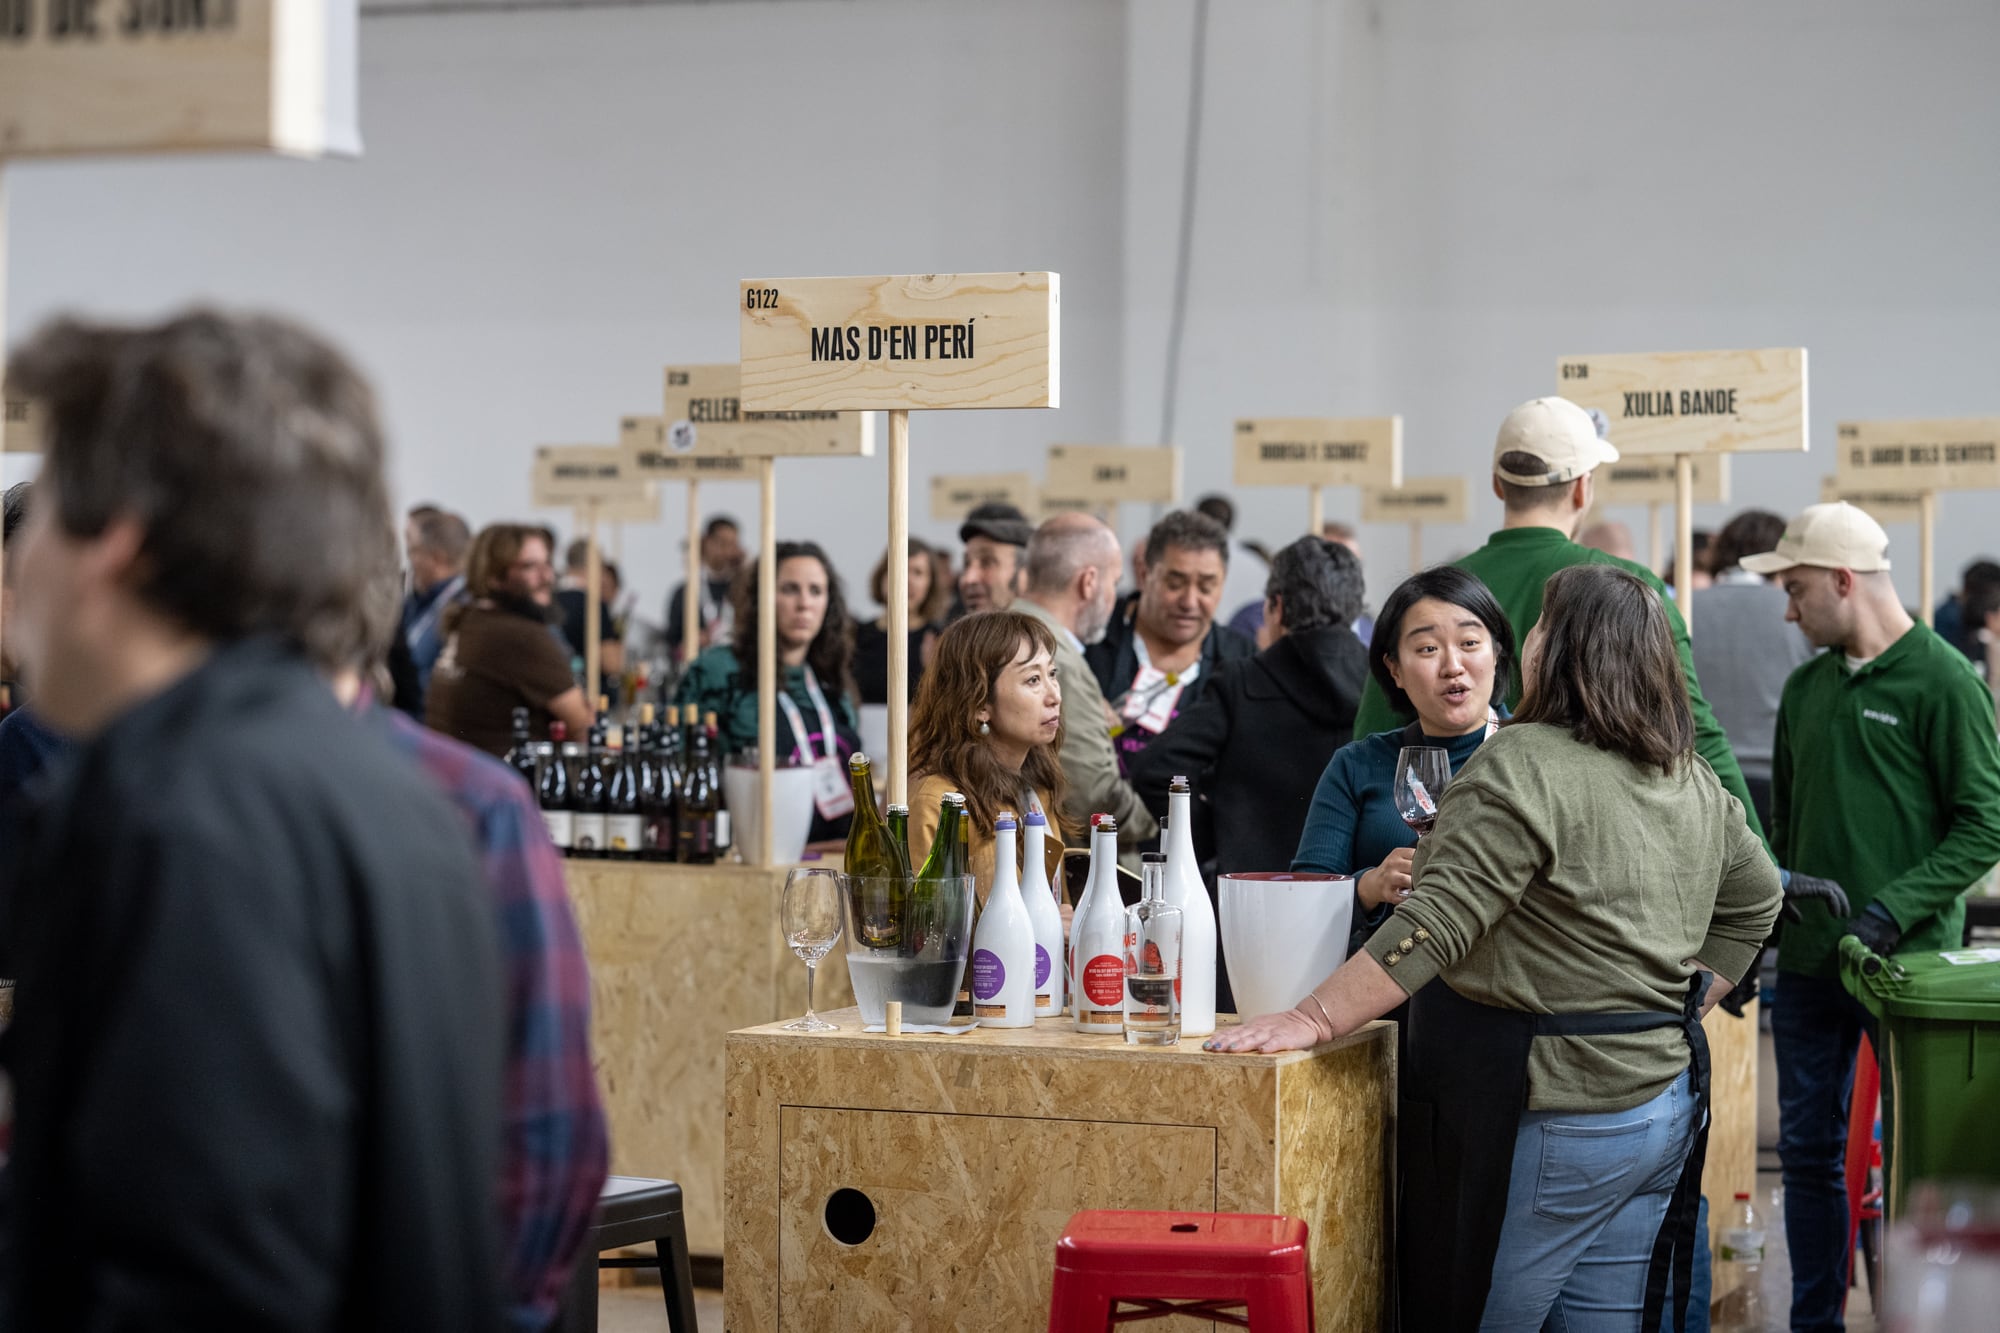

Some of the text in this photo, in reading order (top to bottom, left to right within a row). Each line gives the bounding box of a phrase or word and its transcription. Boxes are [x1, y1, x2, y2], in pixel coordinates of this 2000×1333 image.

[747, 288, 778, 309] G122
[811, 317, 975, 361] MAS D'EN PERÍ
[689, 398, 740, 424] CELLER
[1623, 388, 1737, 418] XULIA BANDE
